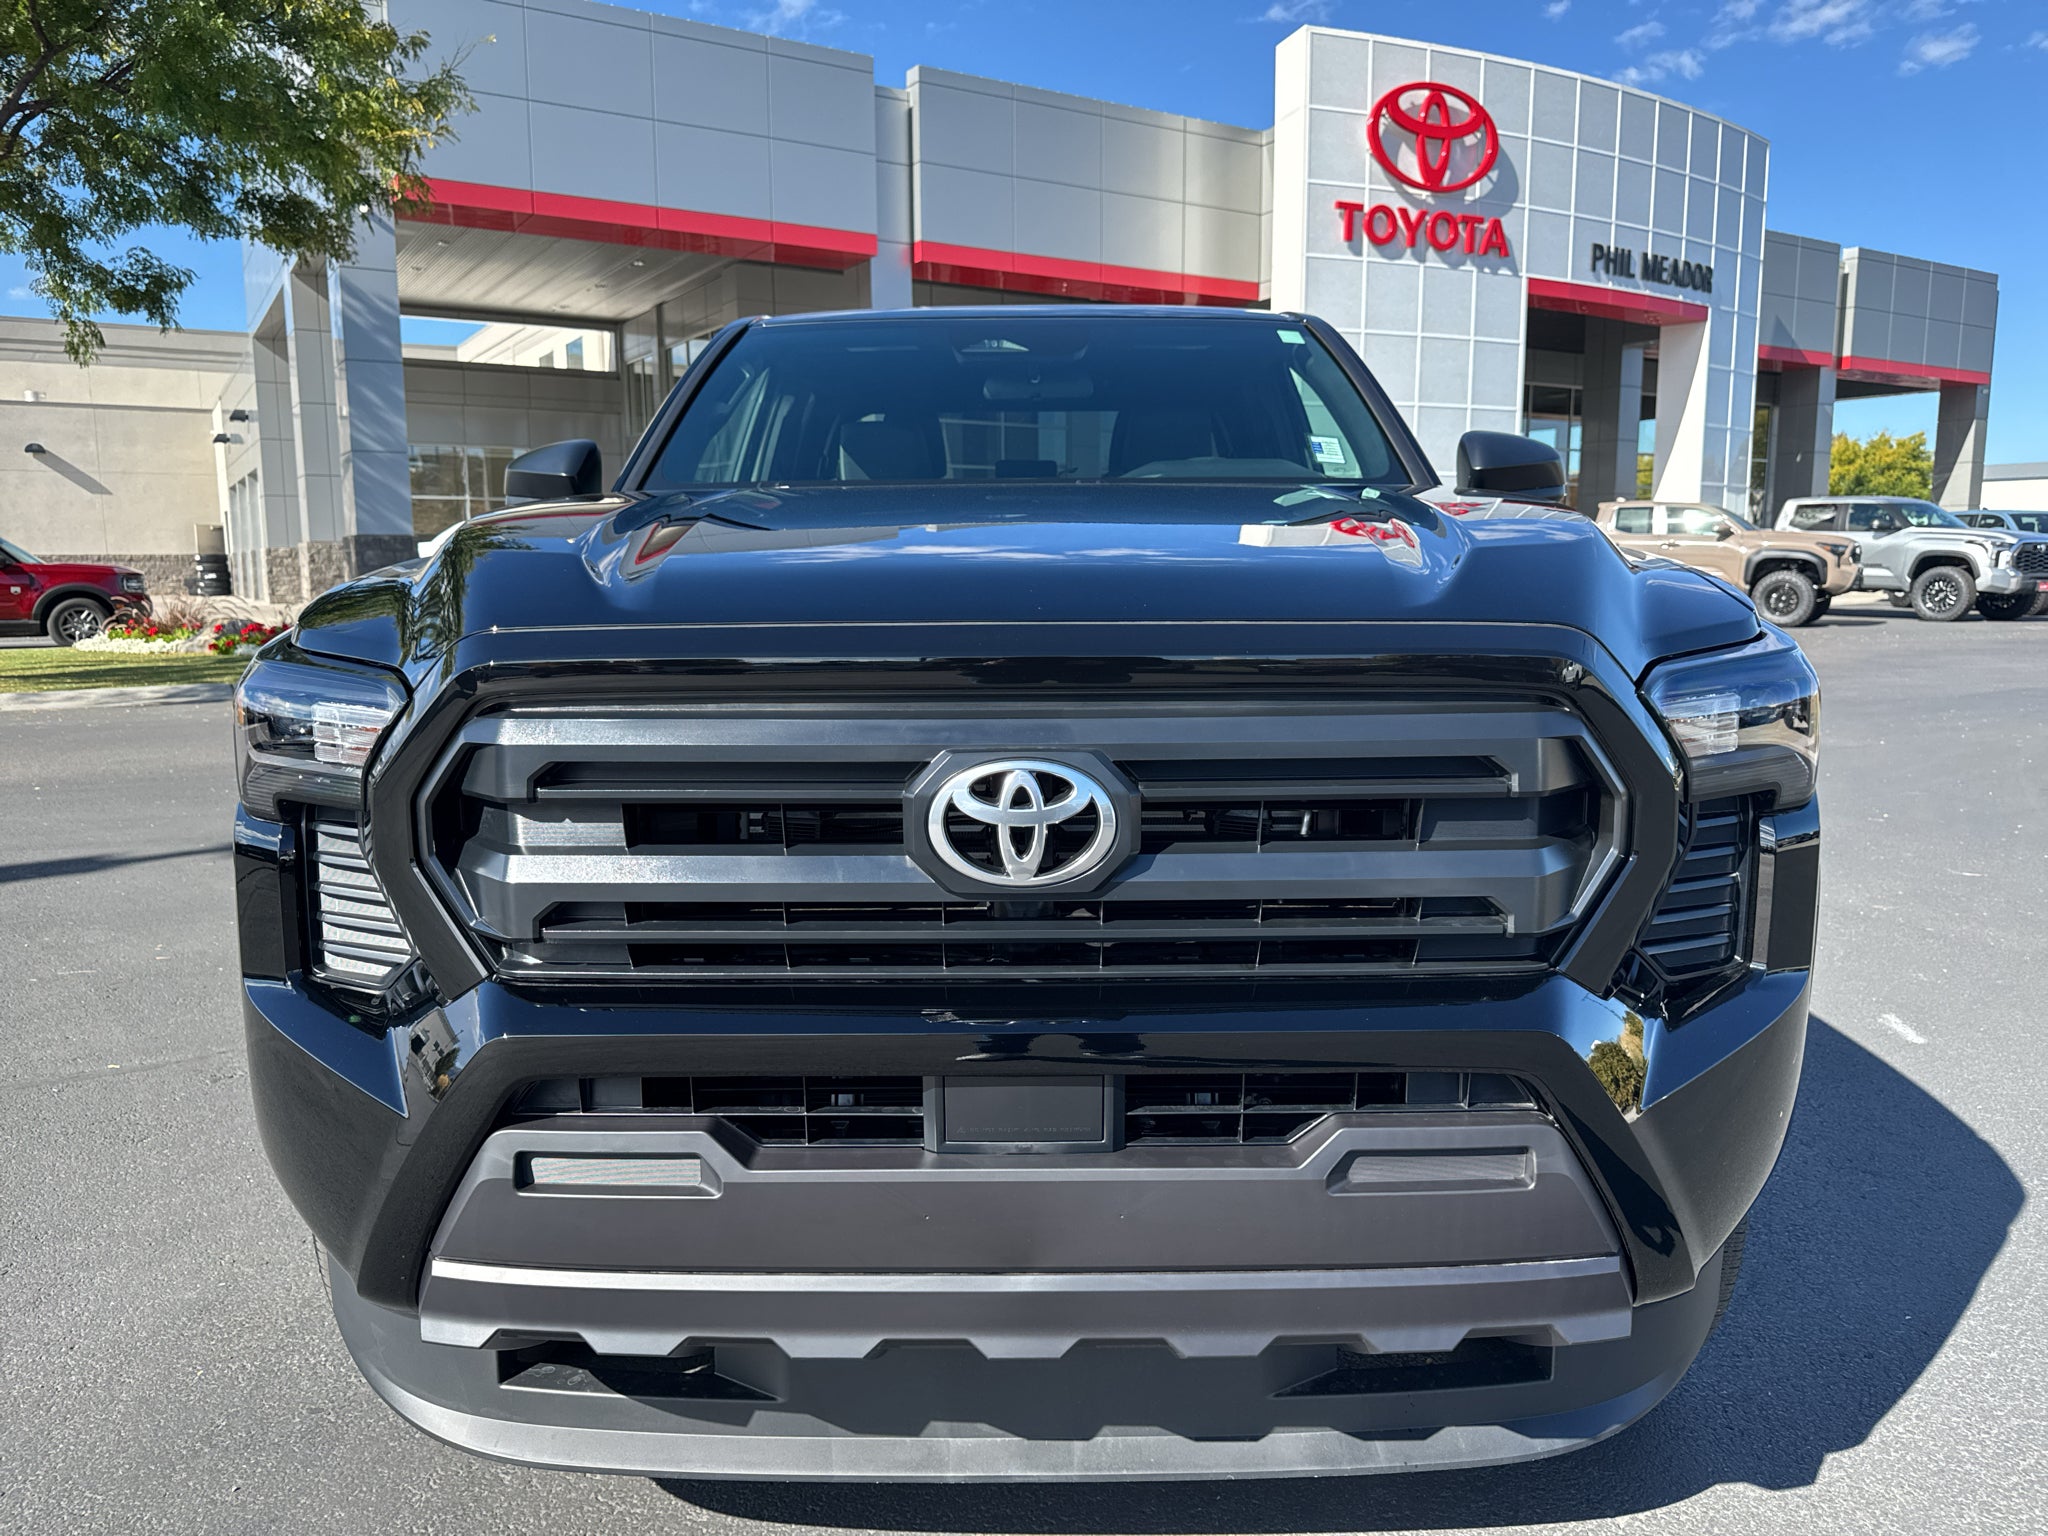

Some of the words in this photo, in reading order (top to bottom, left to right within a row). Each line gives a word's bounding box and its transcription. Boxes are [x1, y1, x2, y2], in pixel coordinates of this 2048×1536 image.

[1335, 201, 1510, 257] TOYOTA
[1592, 243, 1635, 278] PHIL
[1641, 252, 1713, 293] MEADOR
